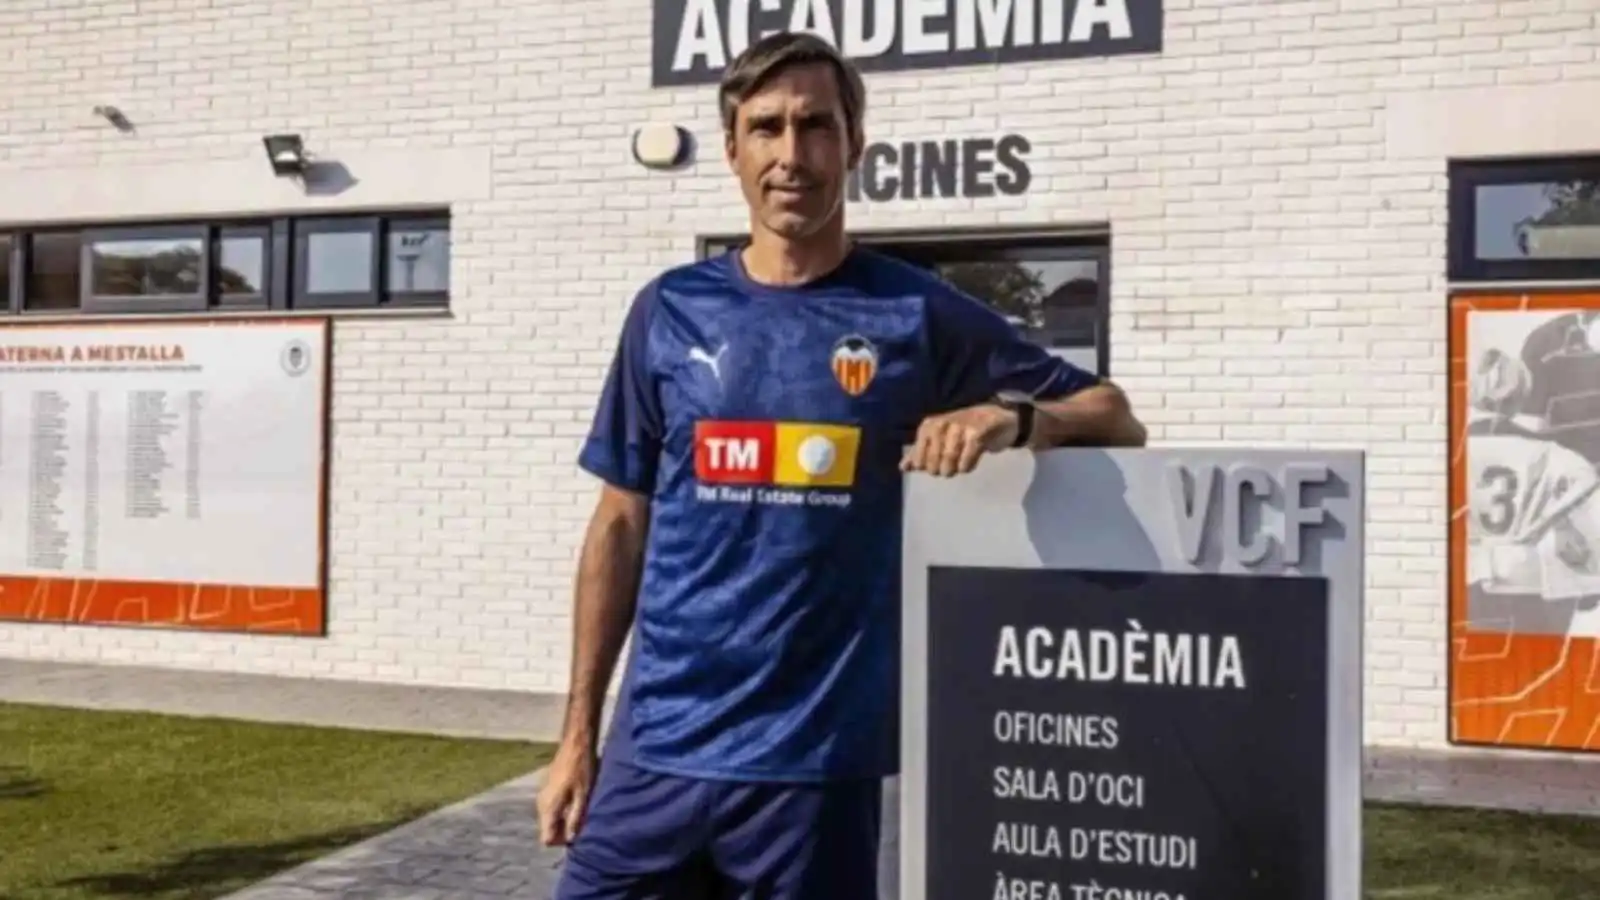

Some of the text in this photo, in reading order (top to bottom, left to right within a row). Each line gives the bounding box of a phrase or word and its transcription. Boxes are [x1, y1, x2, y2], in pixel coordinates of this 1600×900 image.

[71, 346, 83, 361] A
[87, 344, 184, 361] MESTALLA
[704, 437, 760, 471] TM
[720, 486, 752, 502] Real
[757, 489, 804, 504] Estate
[1480, 465, 1518, 535] 3
[1164, 461, 1330, 567] VCF
[992, 619, 1246, 689] ACADÈMIA
[994, 711, 1119, 749] OFICINES
[993, 767, 1060, 800] SALA
[992, 822, 1062, 858] AULA
